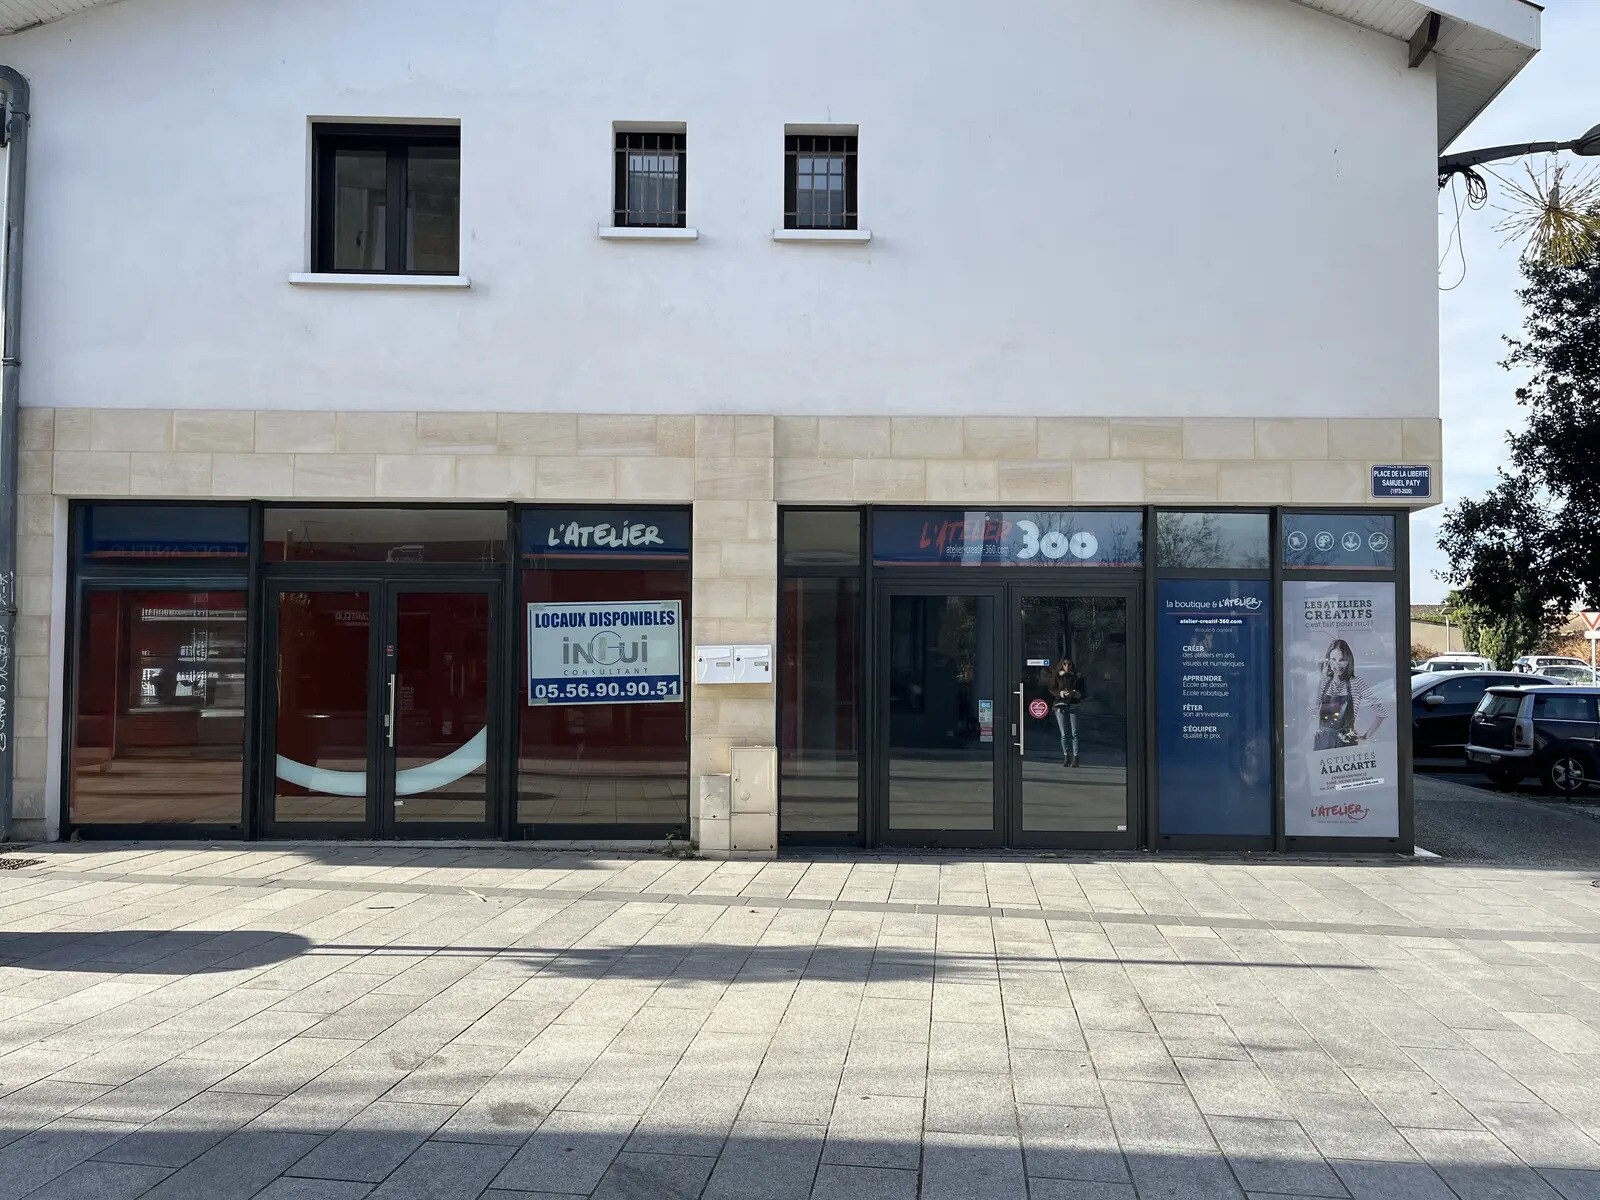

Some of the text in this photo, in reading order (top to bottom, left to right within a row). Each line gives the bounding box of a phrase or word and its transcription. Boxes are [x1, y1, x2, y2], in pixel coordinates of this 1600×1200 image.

[946, 544, 1010, 556] atelier-creatif-360.com
[1175, 600, 1210, 609] boutique
[1324, 600, 1372, 610] ATELIERS
[535, 610, 676, 628] LOCAUX DISPONIBLES
[564, 668, 648, 676] CONSULTANT
[536, 681, 678, 698] 05.56.90.90.51
[1183, 703, 1202, 711] FÊTER
[1329, 765, 1342, 774] LA
[1343, 760, 1376, 772] CARTE
